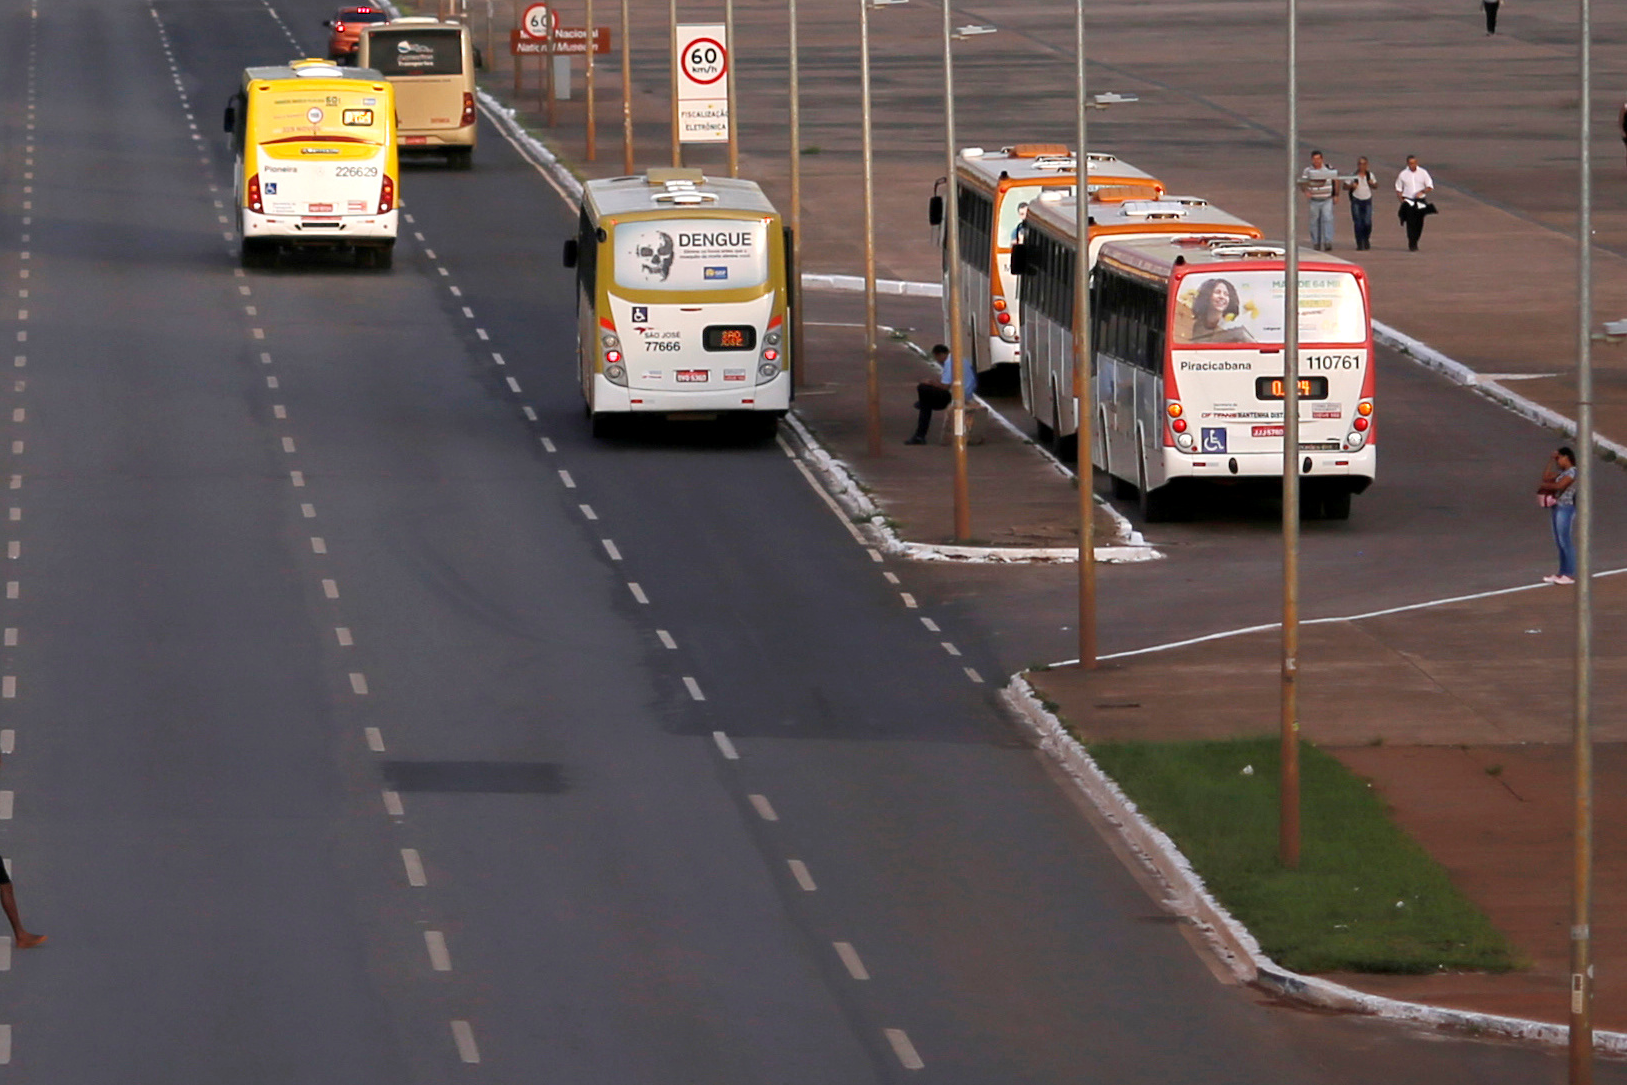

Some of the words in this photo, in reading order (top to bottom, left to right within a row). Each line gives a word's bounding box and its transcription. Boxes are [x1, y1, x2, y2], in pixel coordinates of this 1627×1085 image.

[554, 29, 599, 39] Nacionl
[516, 41, 556, 53] Nationl
[691, 48, 717, 65] 60
[692, 65, 718, 74] km/h
[685, 122, 727, 132] ELETRÔNICA
[264, 165, 298, 173] Pioneira
[335, 166, 378, 177] 226629
[678, 232, 752, 247] DENGUE
[1298, 278, 1311, 288] DE
[1312, 278, 1325, 288] 64
[645, 331, 660, 339] SÃO
[661, 331, 682, 339] JOSÉ
[645, 341, 681, 352] 77666
[1180, 361, 1252, 370] Piracicabana
[1306, 356, 1361, 369] 110761
